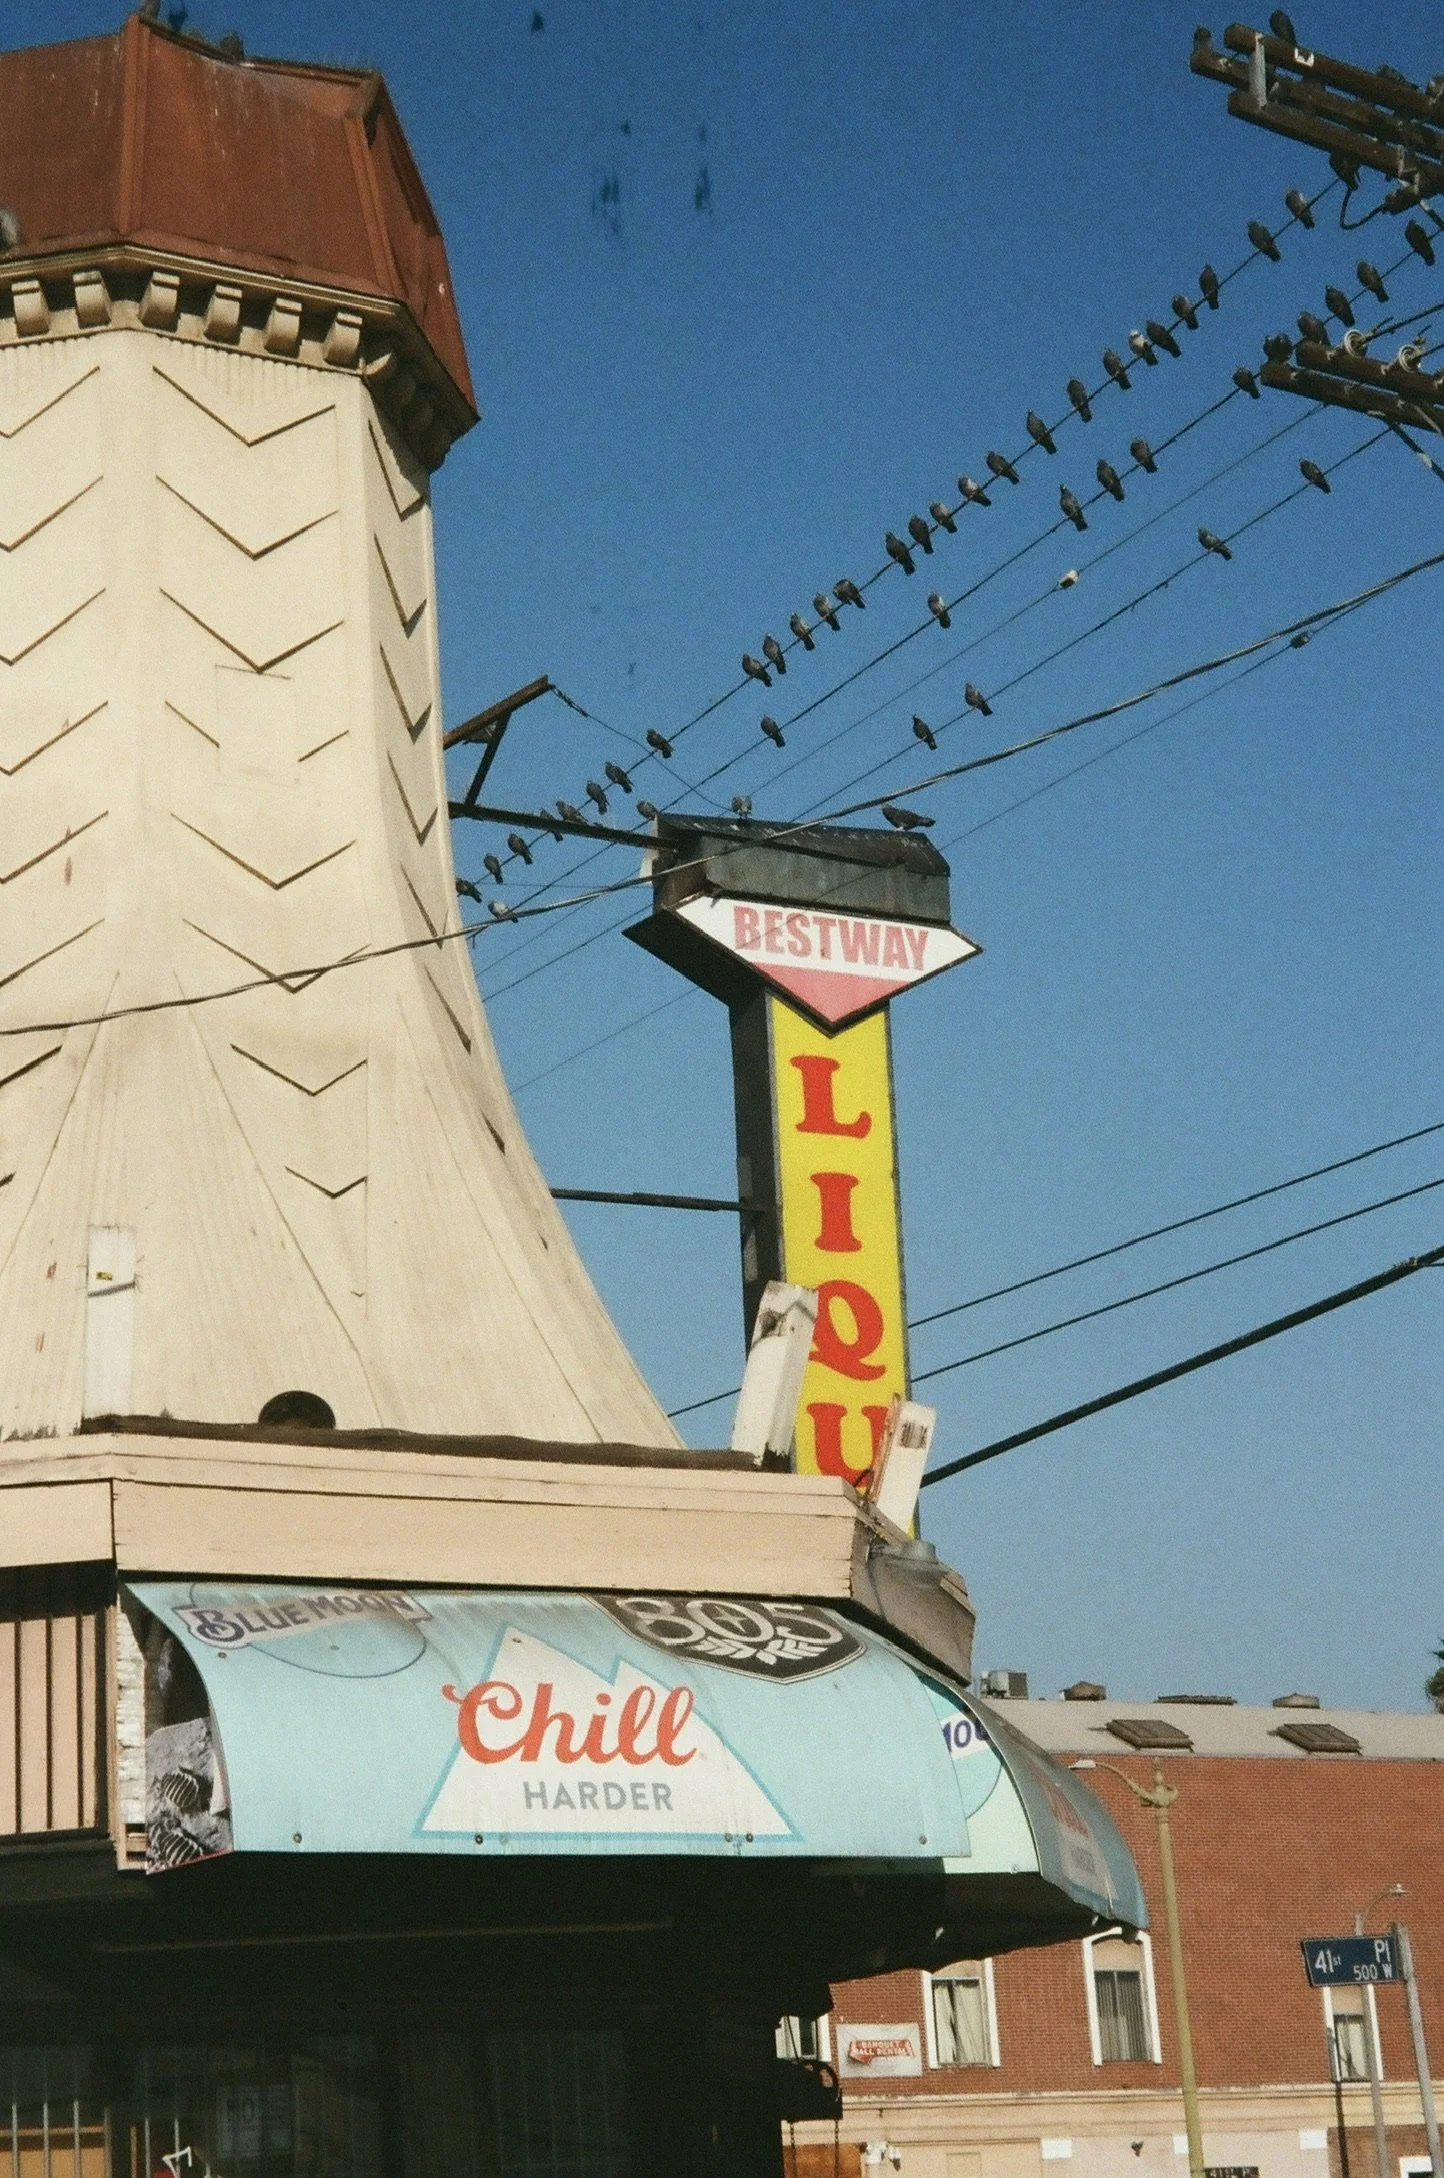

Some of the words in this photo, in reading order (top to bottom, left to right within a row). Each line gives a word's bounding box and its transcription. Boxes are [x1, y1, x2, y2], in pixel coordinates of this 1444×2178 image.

[733, 905, 929, 972] BESTWAY
[192, 1603, 310, 1642] BLUE
[303, 1594, 415, 1620] MOON
[616, 1598, 843, 1646] 805
[441, 1680, 698, 1767] Chill
[523, 1780, 675, 1811] HARDER
[1314, 1948, 1342, 1974] 41st
[1373, 1939, 1391, 1963] Pl
[1353, 1963, 1379, 1981] 500
[1382, 1963, 1393, 1979] W
